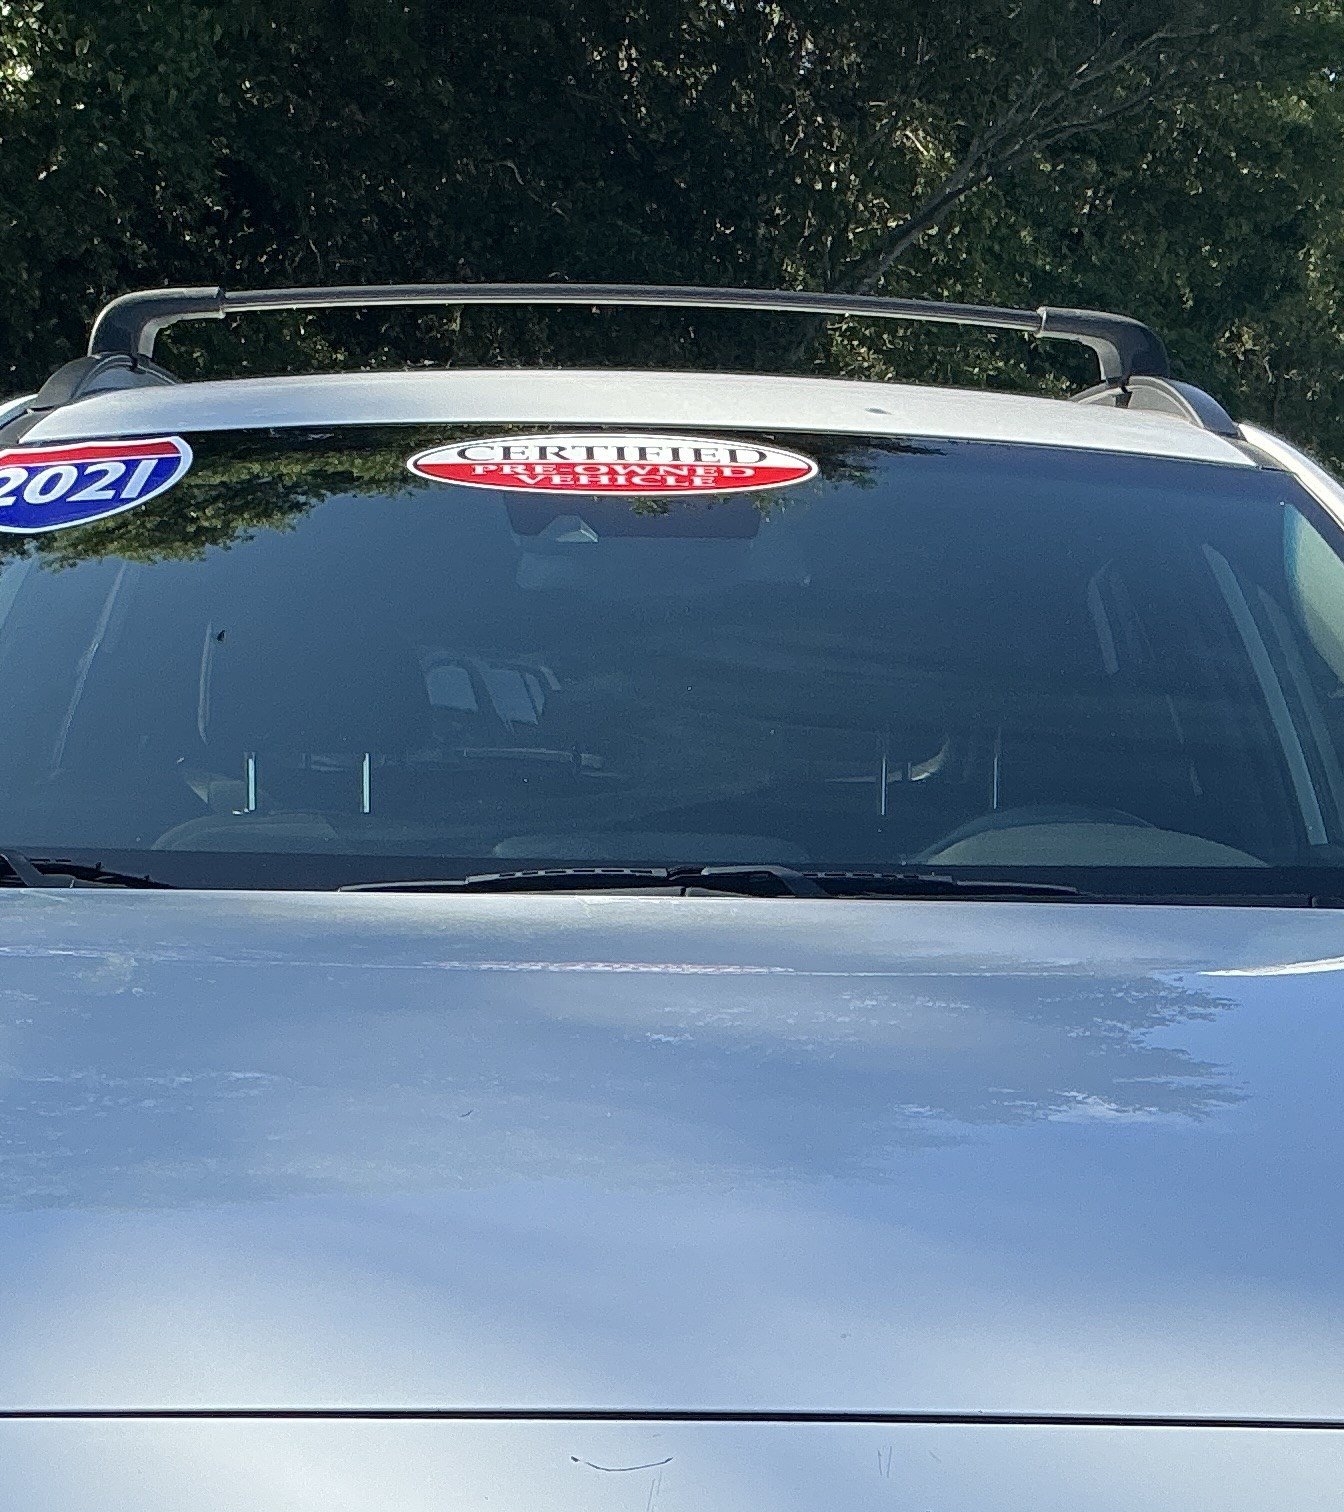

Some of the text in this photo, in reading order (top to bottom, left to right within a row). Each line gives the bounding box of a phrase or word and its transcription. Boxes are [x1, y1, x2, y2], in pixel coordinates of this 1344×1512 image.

[457, 445, 767, 465] CERTIFIED
[471, 464, 755, 478] PRE-OWNED
[519, 475, 717, 487] VEHICLE
